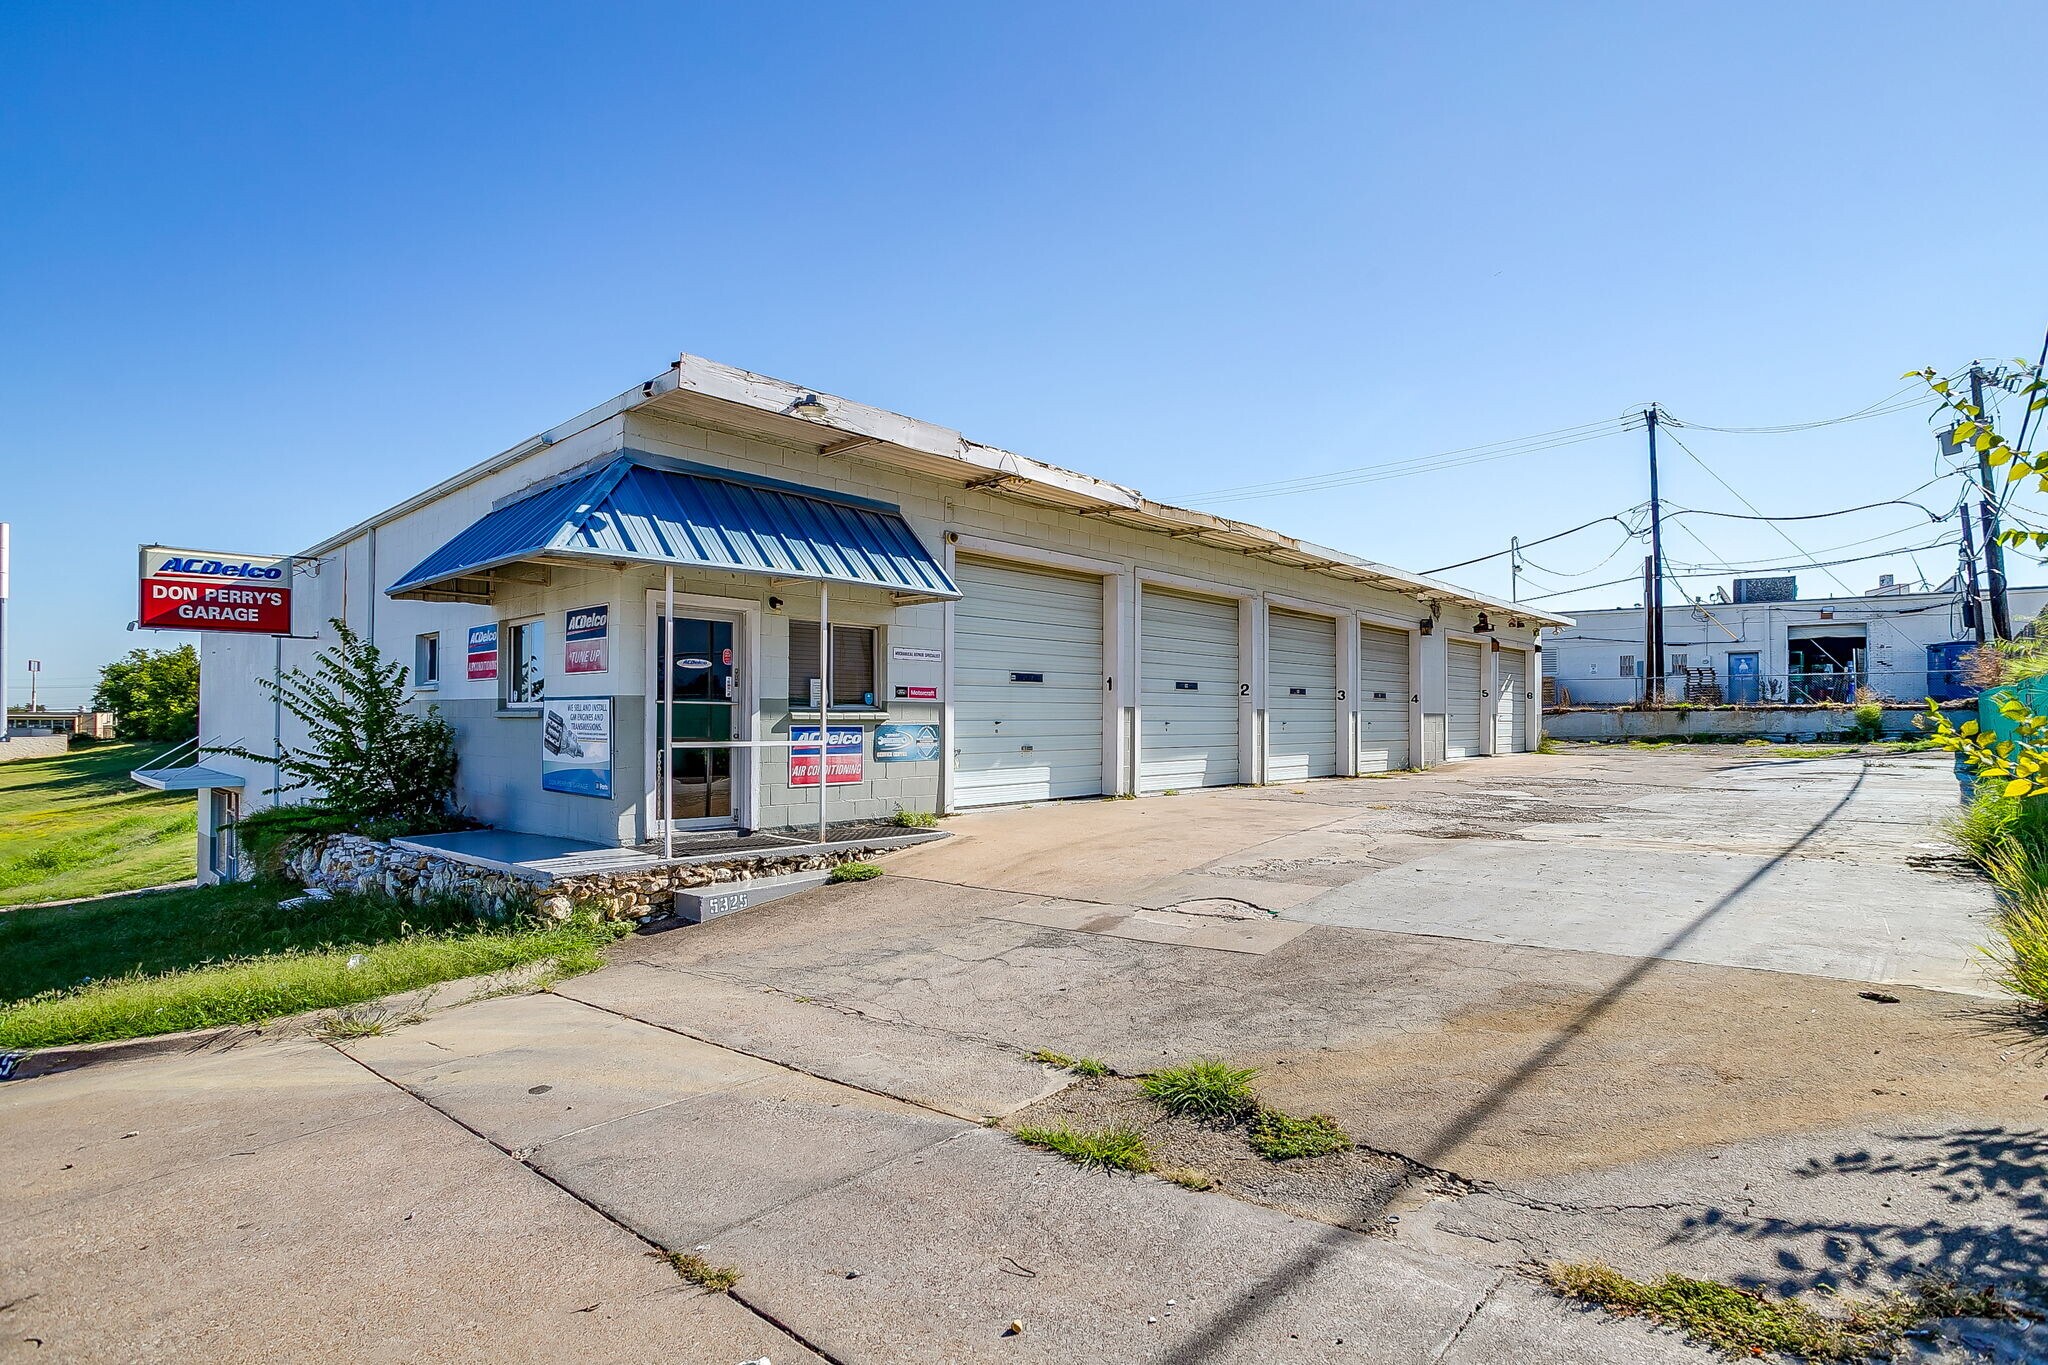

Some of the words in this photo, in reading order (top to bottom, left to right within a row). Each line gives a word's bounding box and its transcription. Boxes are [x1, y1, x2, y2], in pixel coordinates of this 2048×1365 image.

[157, 557, 282, 580] ACDelco
[152, 585, 198, 601] DON
[205, 588, 282, 606] PERRY'S
[178, 605, 259, 622] GARAGE
[568, 612, 607, 630] ACDelco
[470, 630, 497, 644] ACDelco
[590, 650, 601, 662] UP
[1106, 676, 1113, 691] 1
[1240, 683, 1250, 696] 2
[1337, 690, 1346, 701] 3
[1410, 694, 1420, 704] 4
[1481, 689, 1489, 698] 5
[1526, 692, 1534, 700] 6
[792, 765, 807, 777] AIR
[709, 894, 749, 914] 5325
